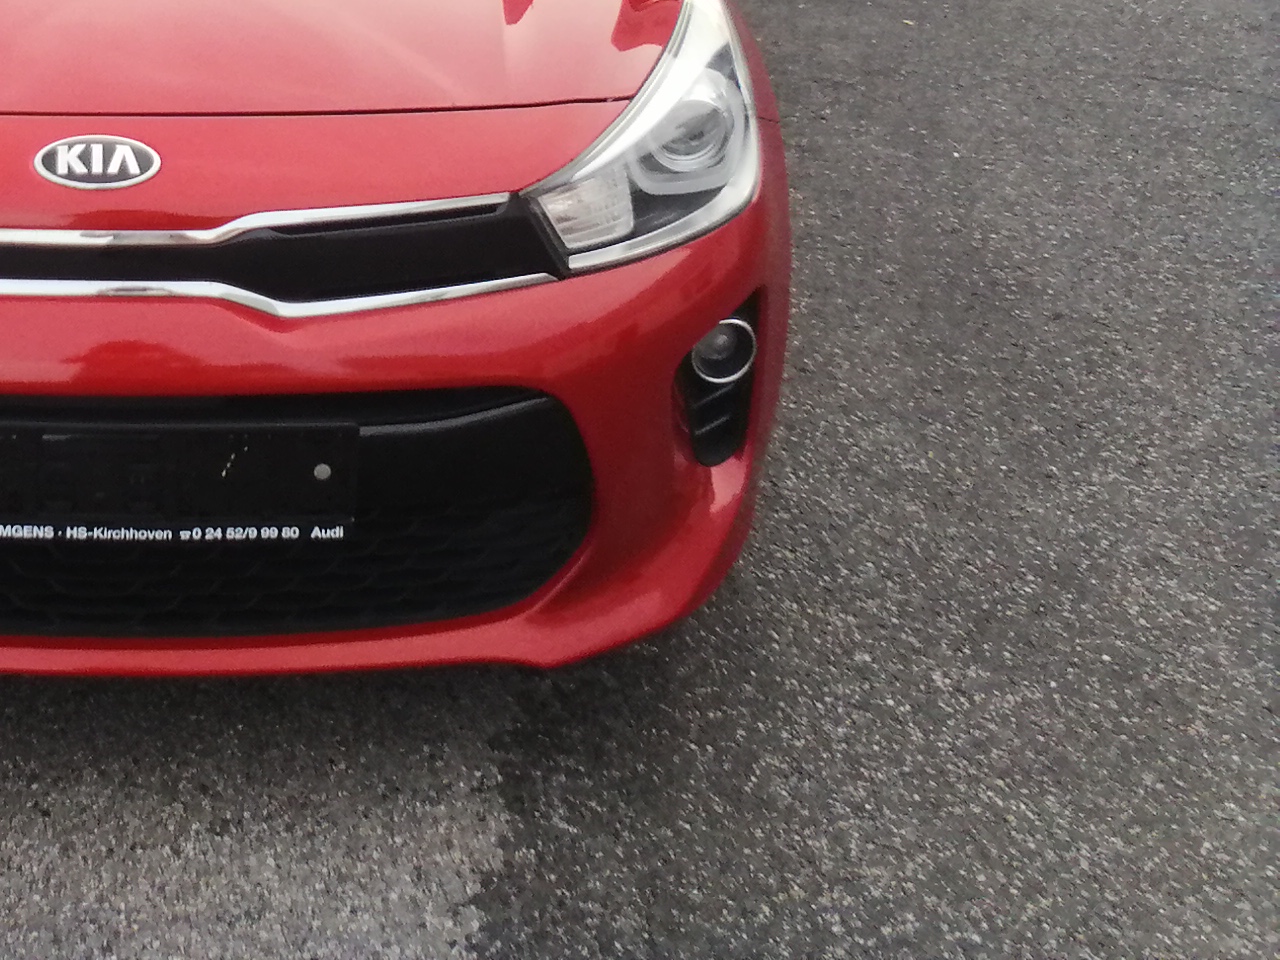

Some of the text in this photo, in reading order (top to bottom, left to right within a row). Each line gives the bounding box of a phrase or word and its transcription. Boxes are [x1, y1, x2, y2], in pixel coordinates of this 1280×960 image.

[56, 143, 141, 175] KIA
[66, 526, 172, 541] HS-Kirchhoven
[311, 526, 344, 539] Audi
